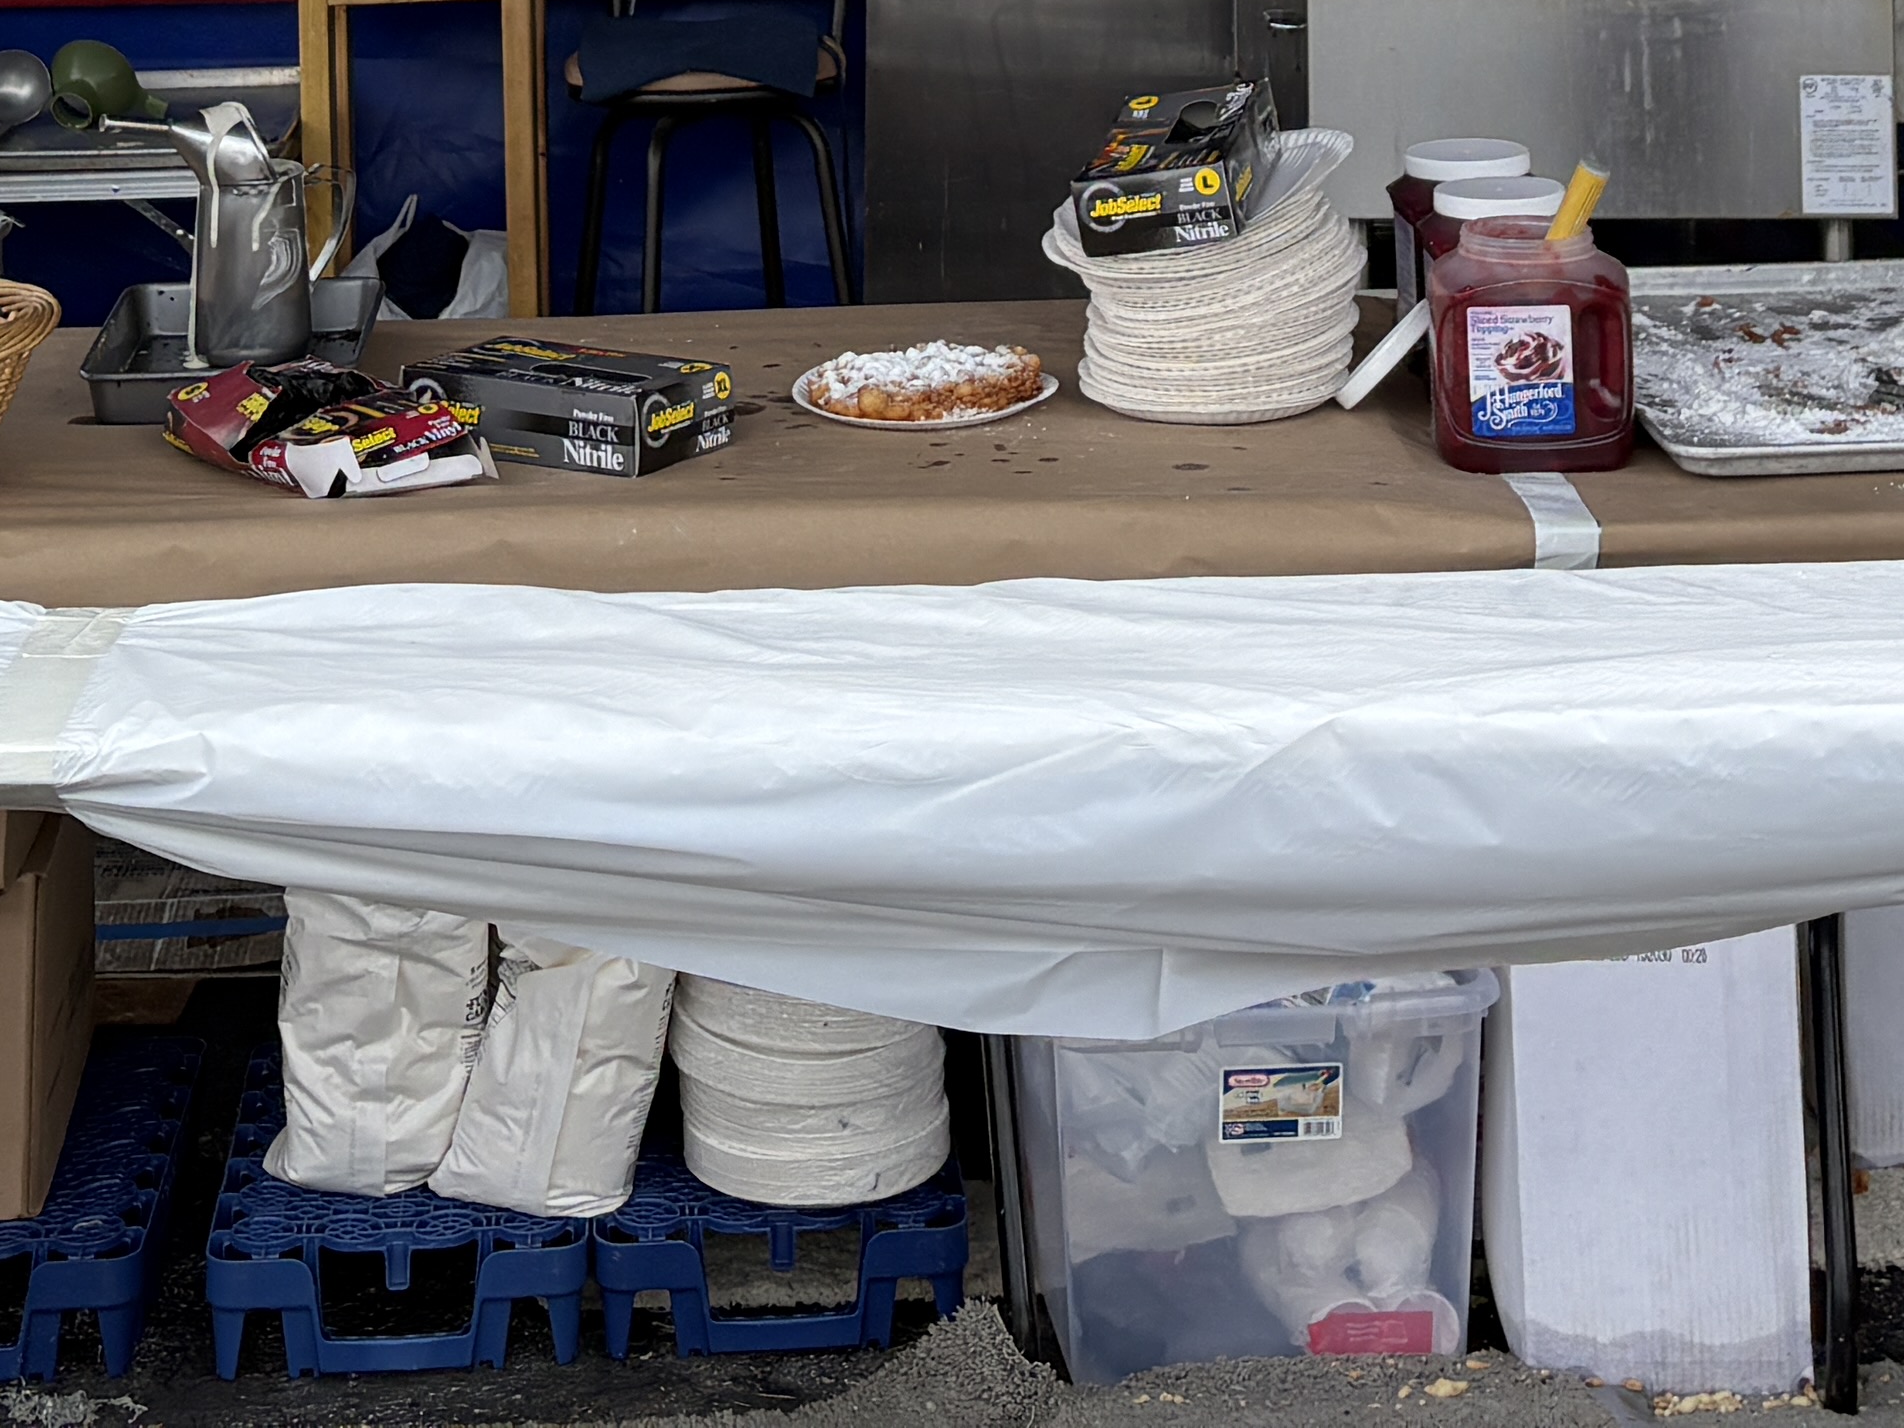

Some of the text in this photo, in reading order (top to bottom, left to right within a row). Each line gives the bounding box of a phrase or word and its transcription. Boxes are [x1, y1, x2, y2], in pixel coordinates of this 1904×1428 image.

[1201, 175, 1214, 189] L
[1089, 193, 1162, 218] JobSelect
[1177, 208, 1222, 224] BLACK
[1173, 221, 1230, 243] Nitrile
[1500, 314, 1554, 325] Strawberry
[1491, 383, 1563, 409] Hungerford
[647, 401, 695, 433] JobSelect
[1489, 401, 1529, 431] Smith
[352, 427, 397, 453] Select
[568, 420, 620, 443] BLACK
[696, 426, 731, 453] Nitrile
[561, 437, 625, 471] Nitrile
